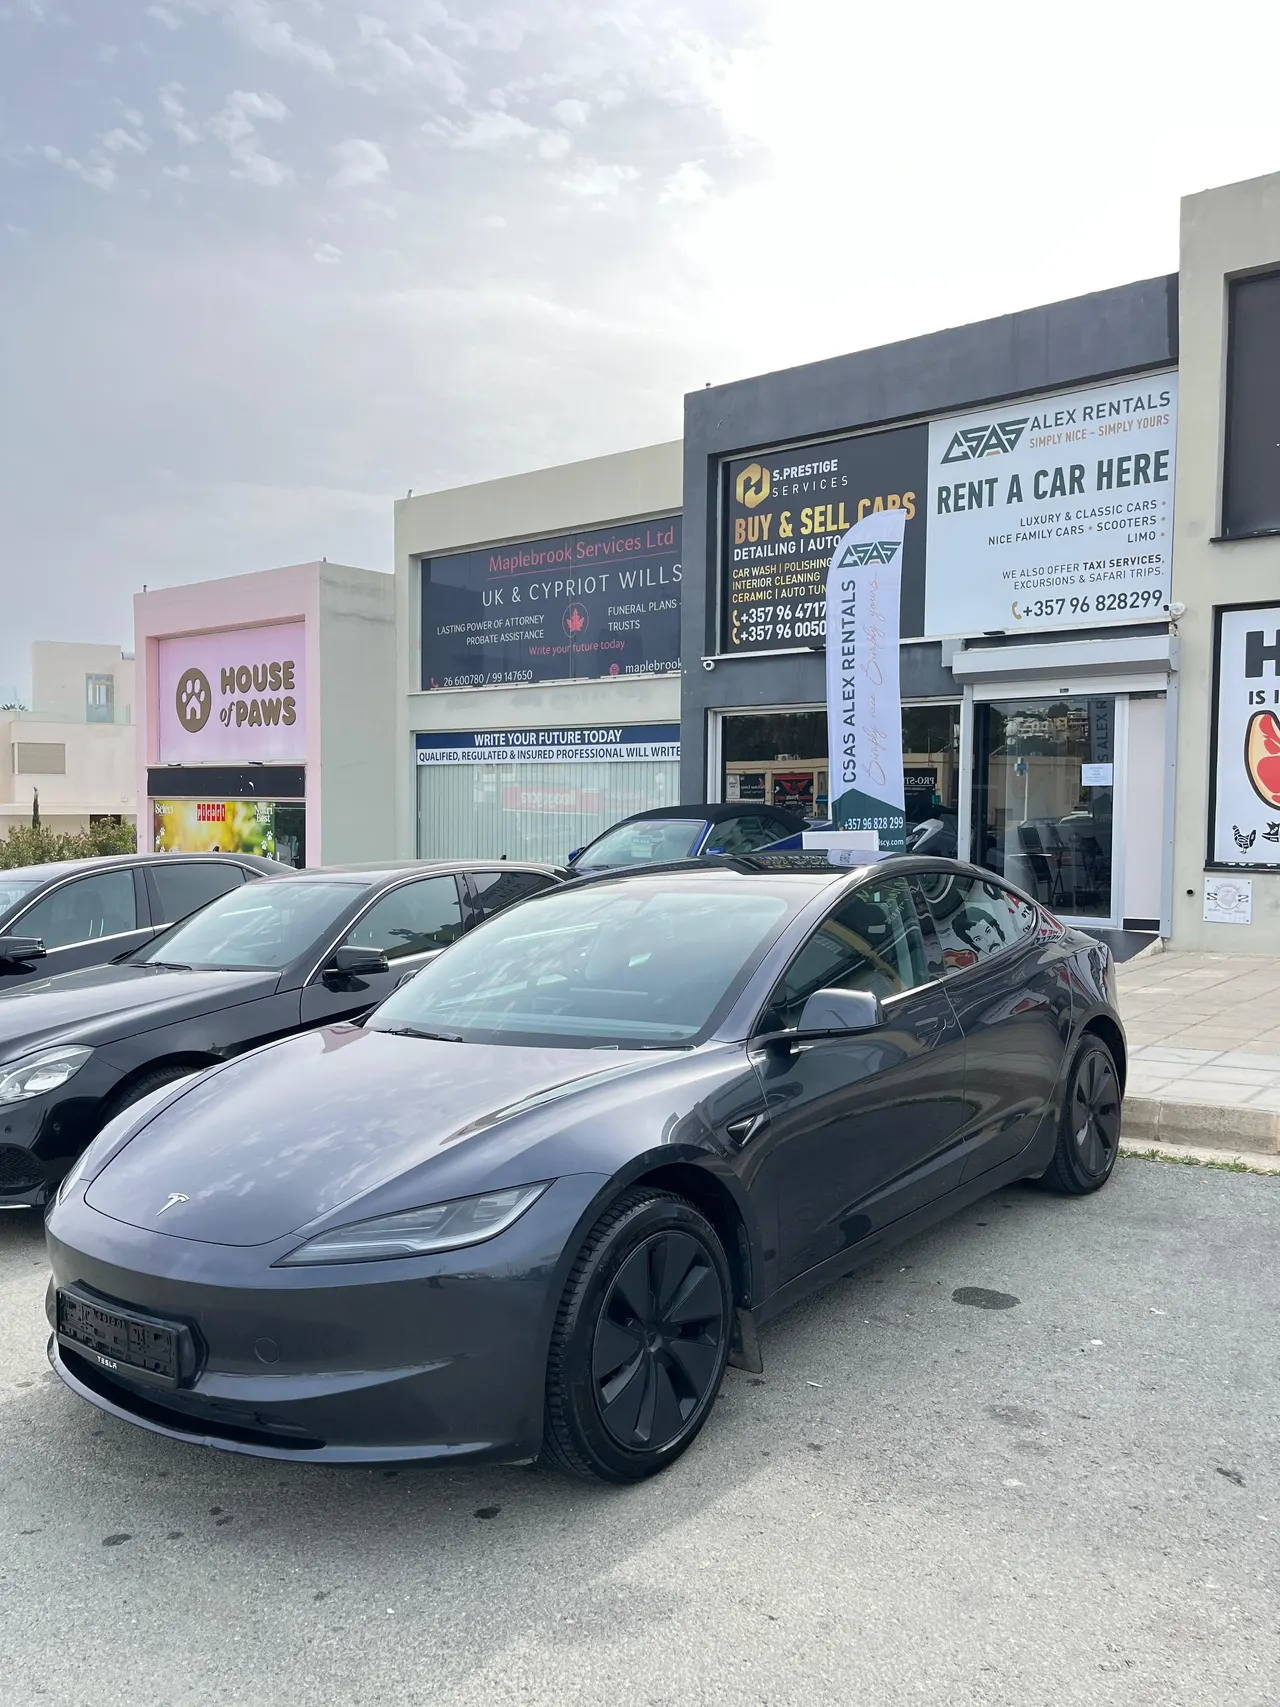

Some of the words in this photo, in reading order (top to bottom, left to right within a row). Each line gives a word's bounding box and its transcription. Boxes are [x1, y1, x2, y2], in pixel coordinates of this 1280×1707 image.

[1030, 409, 1076, 431] ALEX
[1083, 391, 1170, 422] RENTALS
[1030, 432, 1062, 448] SIMPLY
[1065, 429, 1087, 443] NICE
[1099, 420, 1134, 437] SIMPLY
[1137, 414, 1169, 430] YOURS
[772, 459, 838, 481] S.PRESTIGE
[772, 476, 848, 498] SERVICES
[937, 478, 998, 515] RENT
[1006, 474, 1023, 504] A
[1033, 464, 1085, 500] CAR
[1096, 450, 1170, 491] HERE
[734, 514, 772, 544] BUY
[778, 511, 793, 538] &
[800, 502, 850, 535] SELL
[1020, 513, 1061, 527] LUXURY
[1065, 512, 1072, 521] &
[1076, 504, 1123, 519] CLASSIC
[1126, 500, 1157, 513] CARS
[988, 534, 1012, 546] NICE
[1015, 528, 1053, 542] FAMILY
[1056, 525, 1084, 537] CARS
[1096, 515, 1157, 532] SCOOTERS
[1127, 531, 1156, 543] LIMO
[489, 547, 572, 573] Maplebrook
[576, 535, 641, 558] Services
[646, 526, 674, 548] Ltd
[734, 541, 796, 561] DETAILING
[808, 535, 841, 550] AUTO
[732, 566, 749, 578] CAR
[752, 562, 776, 576] WASH
[784, 558, 832, 572] POLISHING
[1002, 569, 1017, 580] WE
[1020, 567, 1045, 578] ALSO
[1047, 563, 1080, 575] OFFER
[1083, 560, 1106, 571] TAXI
[1109, 554, 1165, 568] SERVICES,
[482, 588, 504, 607] UK
[512, 587, 521, 603] &
[529, 574, 610, 600] CYPRIOT
[619, 564, 682, 589] WILLS
[732, 577, 772, 590] INTERIOR
[775, 572, 820, 586] CLEANING
[1014, 576, 1076, 590] EXCURSIONS
[1079, 574, 1086, 584] &
[1089, 569, 1126, 582] SAFARI
[1129, 567, 1164, 578] TRIPS.
[732, 590, 772, 603] CERAMIC
[781, 586, 806, 598] AUTO
[1023, 598, 1065, 617] +357
[1070, 596, 1090, 614] 96
[1095, 589, 1162, 612] 828299
[608, 603, 646, 616] FUNERAL
[649, 599, 676, 611] PLANS
[741, 607, 774, 623] +357
[776, 605, 792, 620] 96
[795, 601, 826, 619] 4717
[437, 624, 465, 635] LASTING
[466, 620, 492, 632] POWER
[494, 619, 502, 629] OF
[505, 615, 544, 627] ATTORNEY
[608, 620, 640, 632] TRUSTS
[741, 625, 773, 641] +357
[776, 623, 792, 639] 96
[795, 621, 826, 637] 0050
[841, 580, 856, 670] RENTALS
[466, 634, 498, 645] PROBATE
[500, 630, 544, 642] ASSISTANCE
[528, 645, 550, 656] Write
[552, 646, 570, 656] your
[572, 640, 598, 652] future
[601, 639, 625, 652] today
[220, 660, 296, 694] HOUSE
[443, 678, 453, 686] 26
[455, 675, 484, 685] 600780
[493, 673, 502, 682] 99
[505, 670, 533, 682] 147650
[842, 676, 855, 726] ALEX
[1249, 690, 1266, 705] IS
[220, 702, 236, 727] of
[236, 696, 296, 727] PAWS
[474, 734, 506, 746] WRITE
[507, 732, 537, 745] YOUR
[539, 731, 581, 744] FUTURE
[583, 729, 622, 743] TODAY
[419, 751, 460, 762] QUALIFIED,
[461, 750, 508, 761] REGULATED
[509, 750, 516, 759] &
[517, 749, 554, 759] INSURED
[556, 748, 624, 759] PROFESSIONAL
[626, 747, 649, 758] WILL
[651, 746, 680, 756] WRITE
[843, 733, 857, 783] CSAS
[844, 818, 861, 830] +357
[863, 818, 872, 829] 96
[874, 817, 887, 829] 828
[889, 816, 903, 829] 299
[97, 1356, 117, 1369] TESLA
